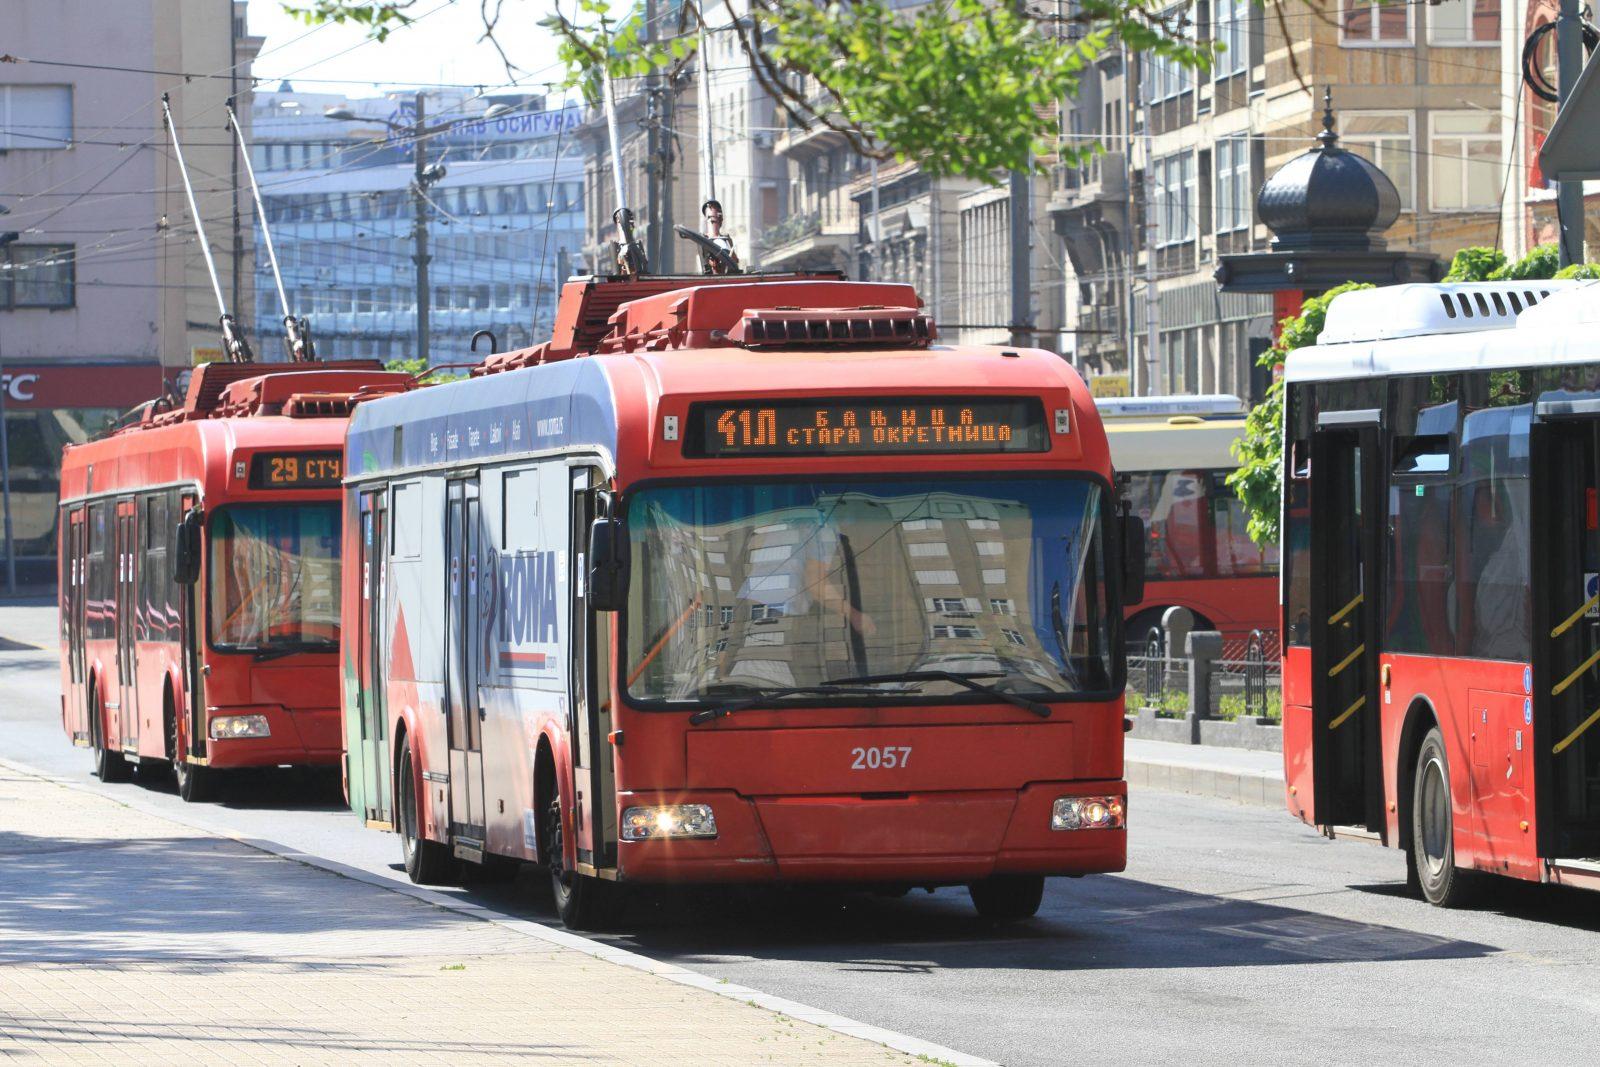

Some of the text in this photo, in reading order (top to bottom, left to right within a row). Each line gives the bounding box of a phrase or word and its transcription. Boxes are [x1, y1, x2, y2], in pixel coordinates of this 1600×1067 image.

[717, 410, 776, 445] 41Л
[787, 425, 1011, 444] СТАРА ОКРЕТНИЦА
[271, 457, 341, 481] 29 СТУ
[500, 549, 559, 646] ROMA
[851, 746, 912, 769] 2057
